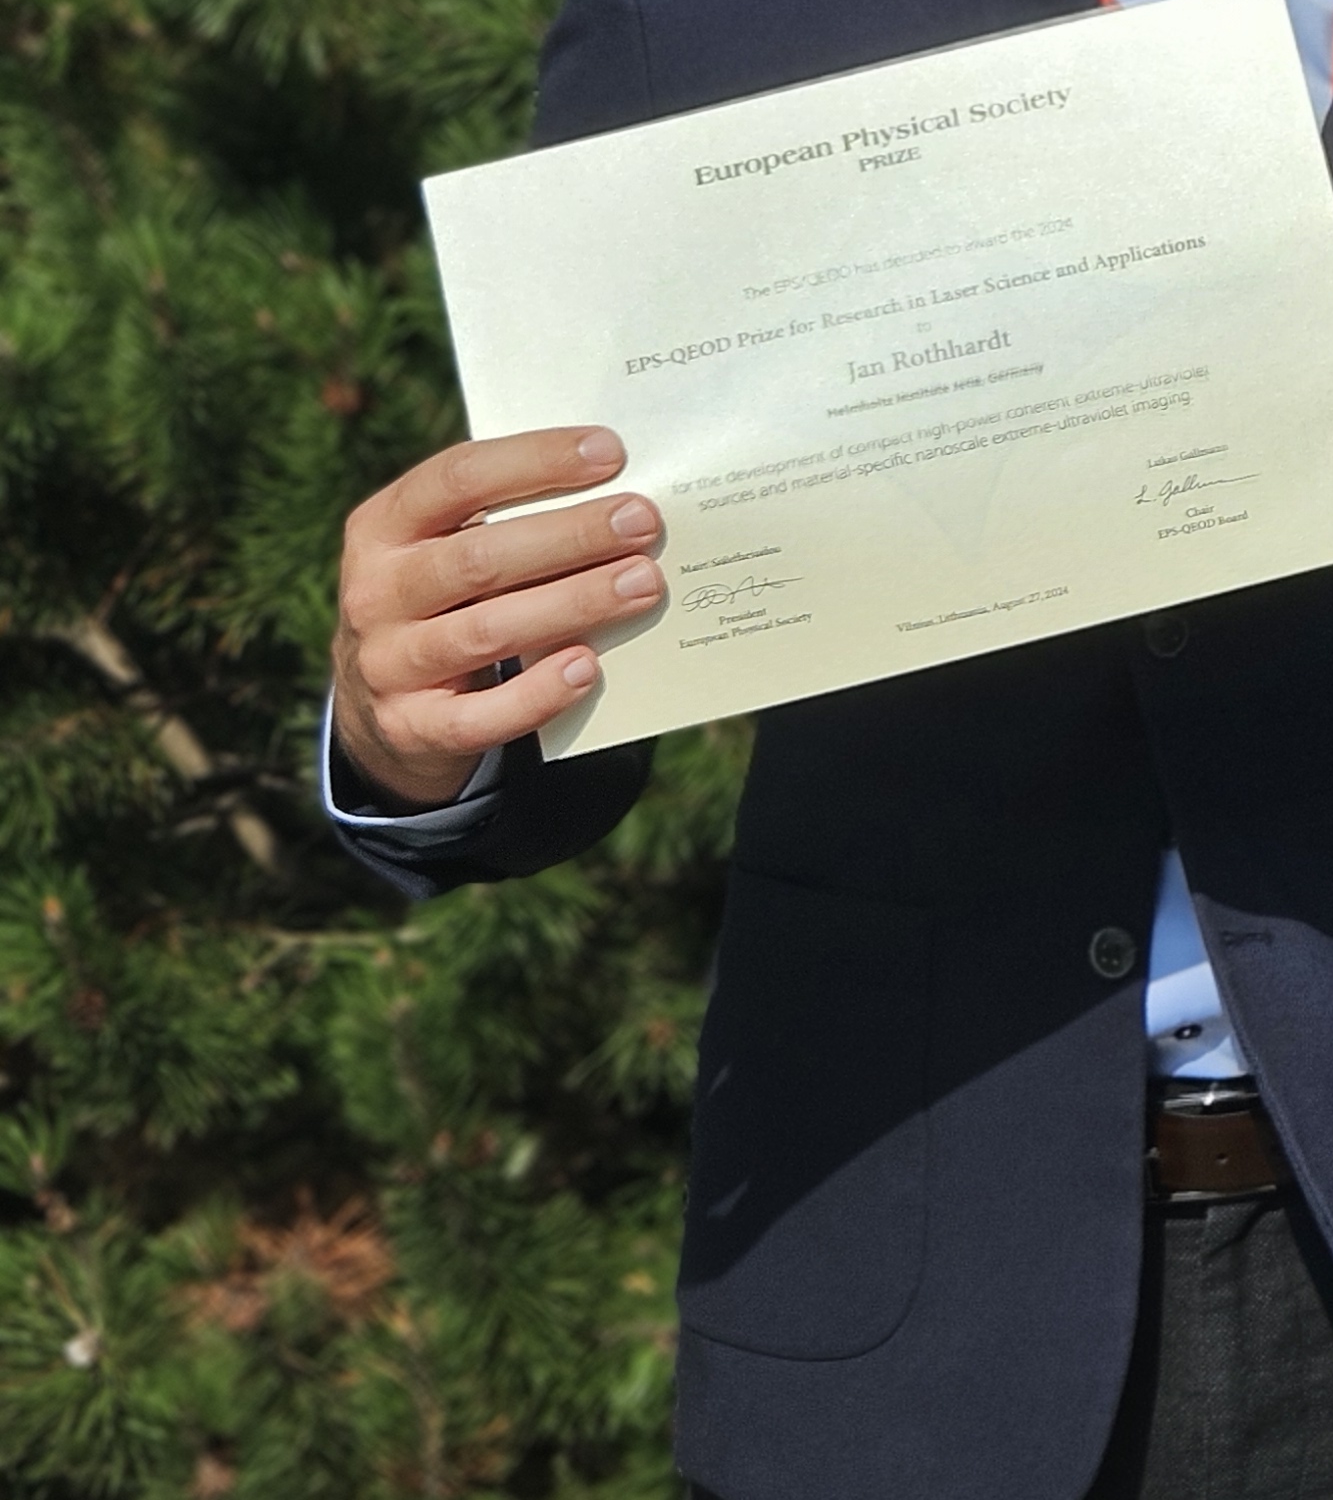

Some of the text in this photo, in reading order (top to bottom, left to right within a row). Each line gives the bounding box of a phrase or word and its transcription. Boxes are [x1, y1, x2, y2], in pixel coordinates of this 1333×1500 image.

[694, 86, 1073, 186] European Physical Society
[859, 146, 922, 172] PRIZE
[742, 284, 771, 301] The
[855, 258, 881, 275] has
[886, 245, 942, 270] decided
[946, 244, 961, 256] to
[964, 230, 1008, 252] award
[1010, 225, 1036, 241] the
[1038, 216, 1074, 237] 2024
[624, 235, 1207, 377] EPS-QEOD Prize for Research in Laser Science and Applications
[916, 321, 932, 333] to
[846, 329, 1012, 385] Jan Rothhardt
[671, 363, 1211, 496] for the development of compact high-power coherent extreme-ultraviolet
[698, 489, 757, 513] sources
[759, 480, 788, 498] and
[791, 451, 914, 490] material-specific
[915, 433, 990, 462] nanoscale
[991, 404, 1131, 445] extreme-ultraviolet
[1157, 509, 1249, 540] EPS-QEOD Board
[1185, 504, 1215, 518] Chair
[1046, 585, 1070, 600] 2024
[679, 611, 812, 649] European Physical Society
[718, 606, 767, 626] President
